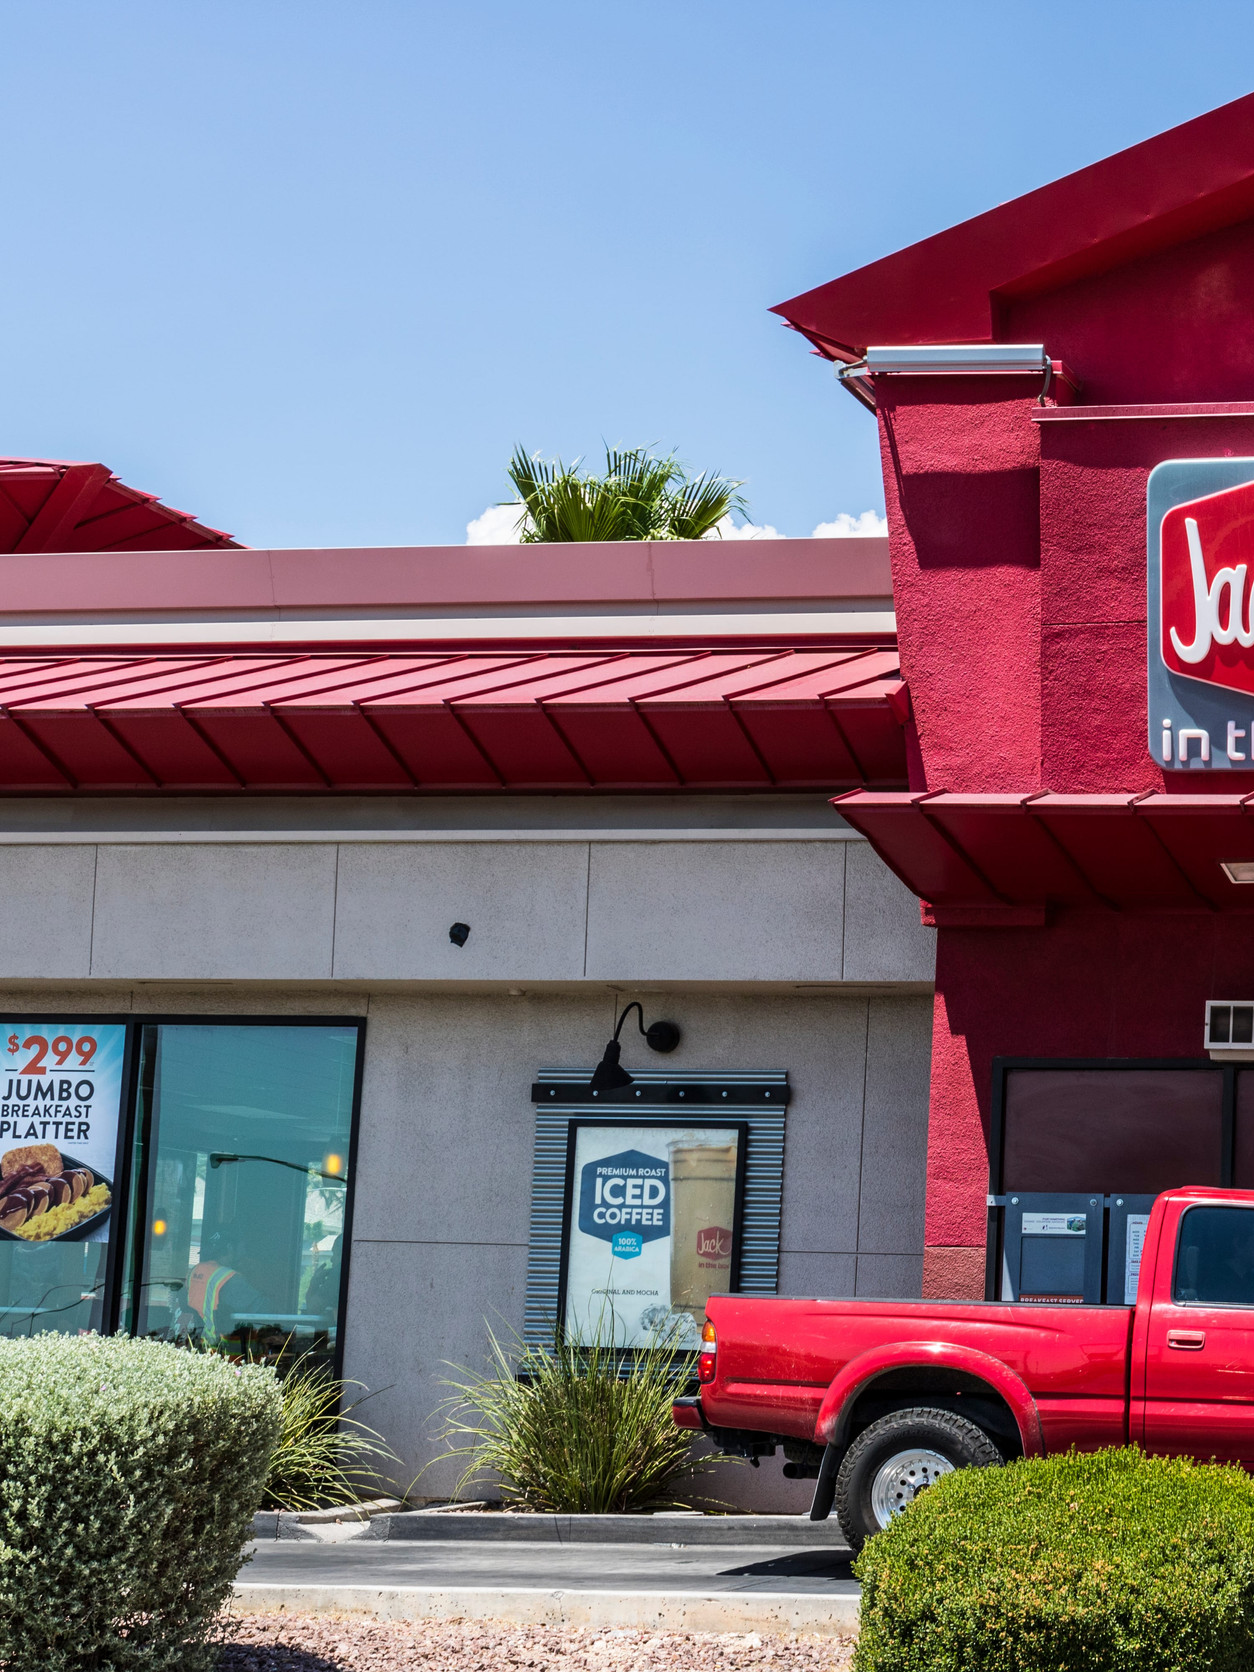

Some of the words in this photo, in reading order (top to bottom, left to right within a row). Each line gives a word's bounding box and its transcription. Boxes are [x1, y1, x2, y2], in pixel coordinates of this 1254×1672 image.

[1162, 718, 1210, 761] in
[6, 1032, 98, 1076] $299
[2, 1079, 94, 1101] JUMBO
[1, 1103, 92, 1119] BREAKFAST
[0, 1120, 91, 1140] PLATTER
[597, 1167, 637, 1176] PREMIUM
[638, 1168, 666, 1177] ROAST
[594, 1177, 666, 1206] ICED
[593, 1207, 663, 1225] COFFEE
[697, 1230, 731, 1255] Jack
